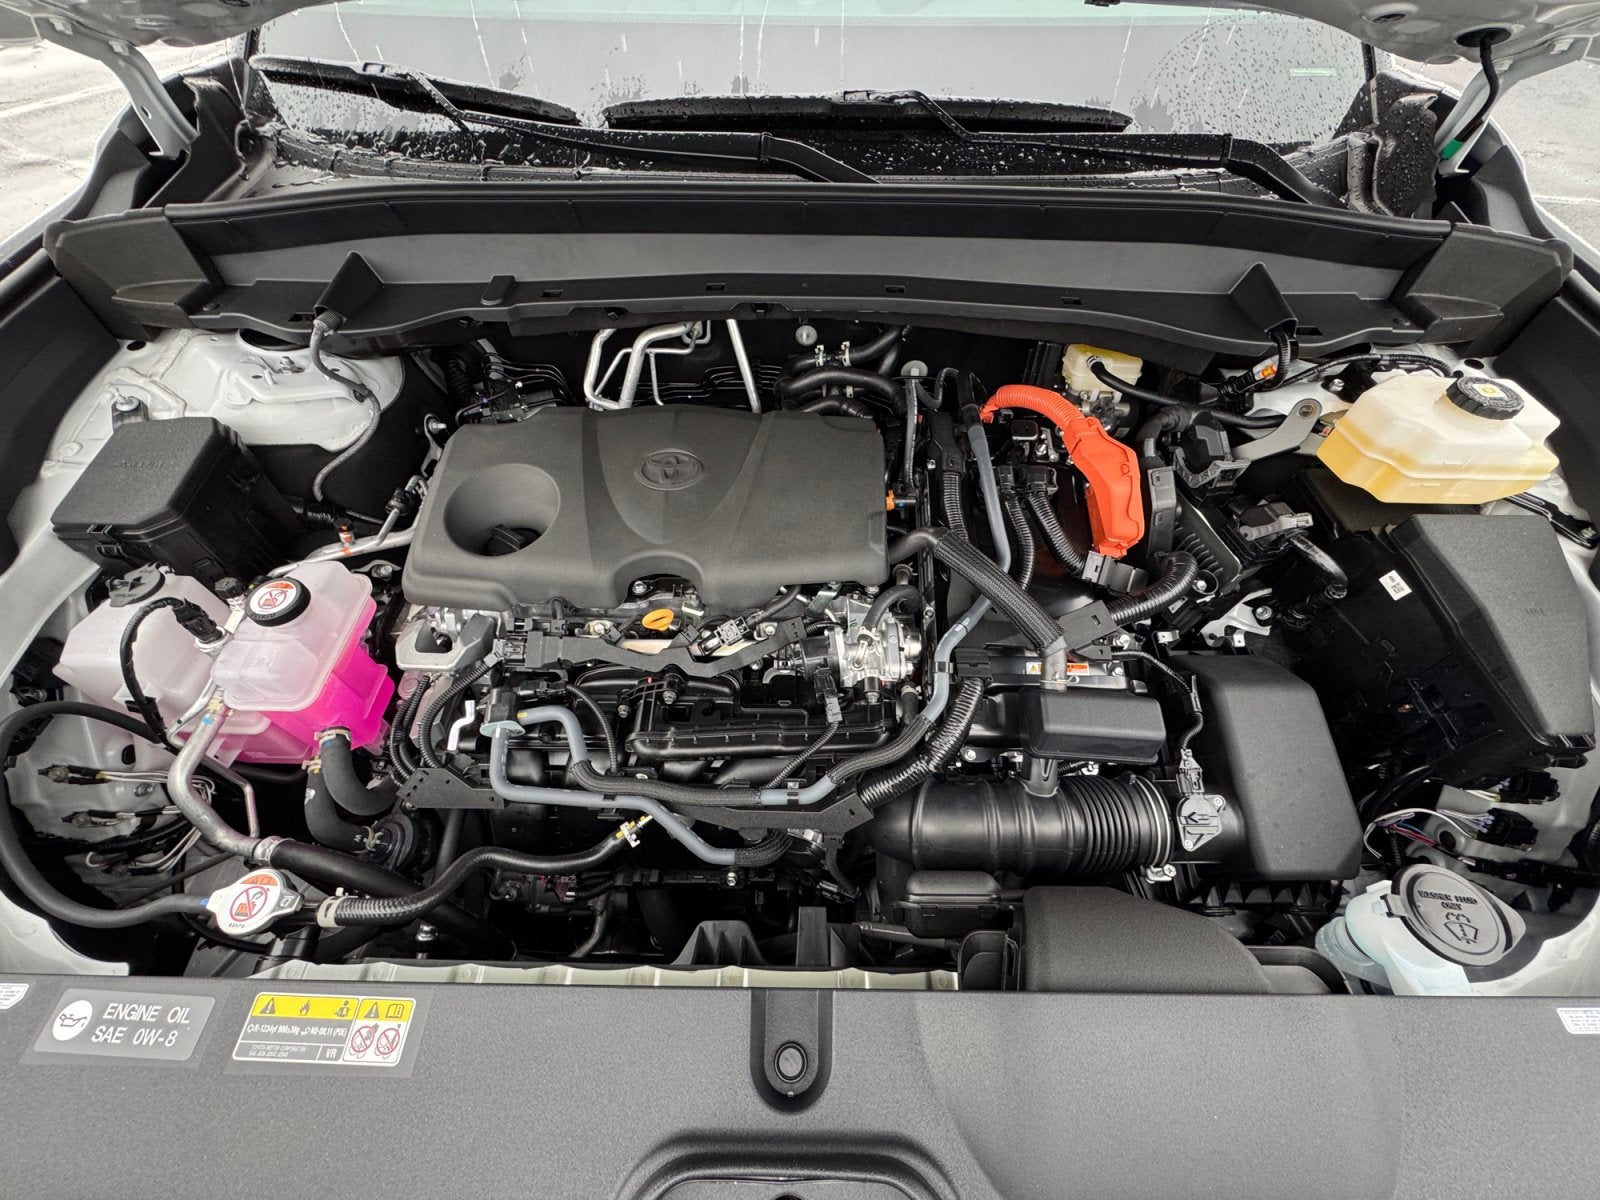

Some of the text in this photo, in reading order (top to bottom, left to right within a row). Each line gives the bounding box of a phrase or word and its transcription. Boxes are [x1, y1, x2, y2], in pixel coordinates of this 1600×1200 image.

[102, 1003, 190, 1024] ENGINE OIL
[91, 1026, 178, 1047] SAE 0W-8
[326, 1048, 337, 1058] VR
